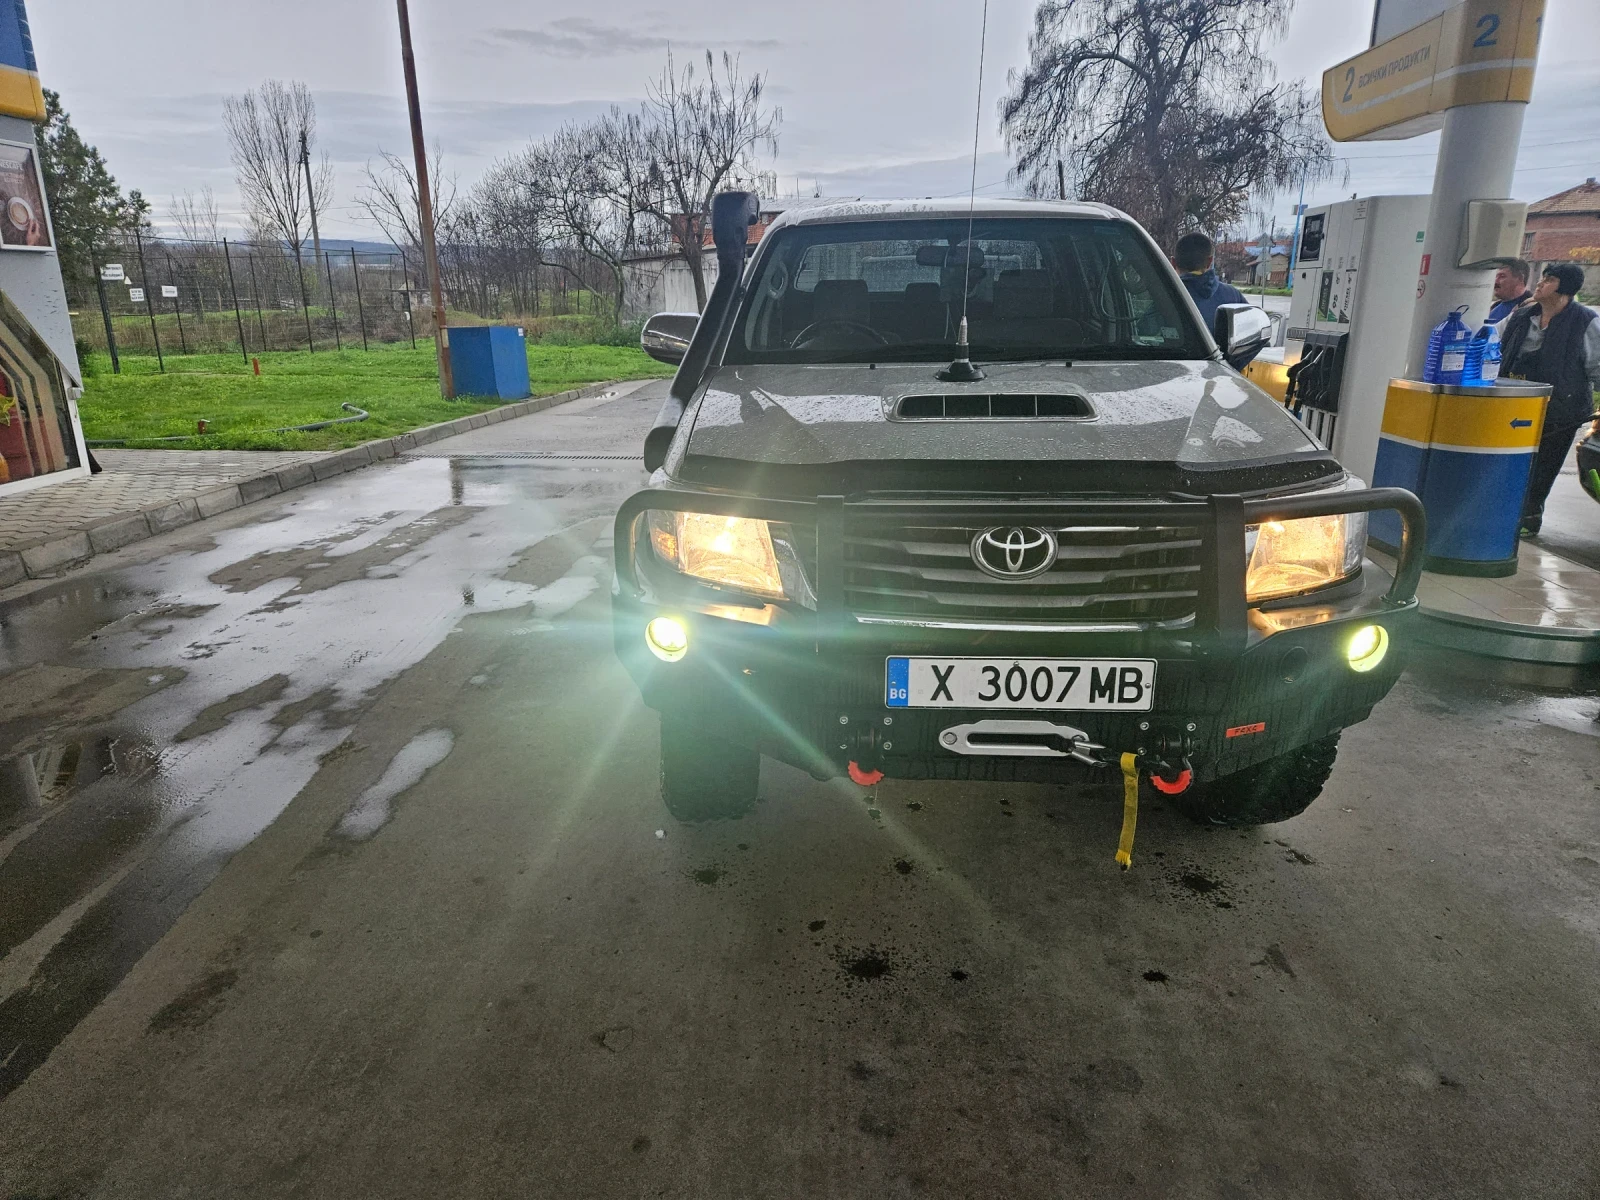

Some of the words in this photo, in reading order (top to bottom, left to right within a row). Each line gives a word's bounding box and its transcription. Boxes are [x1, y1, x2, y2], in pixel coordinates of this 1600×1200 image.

[1473, 14, 1501, 48] 2
[1342, 66, 1356, 103] 2
[1358, 64, 1388, 89] ВСИЧКИ
[1387, 44, 1431, 77] ПРОДУКТИ
[889, 688, 907, 700] BG
[929, 664, 956, 702] X
[978, 664, 1082, 703] 3007
[1088, 666, 1144, 704] MB
